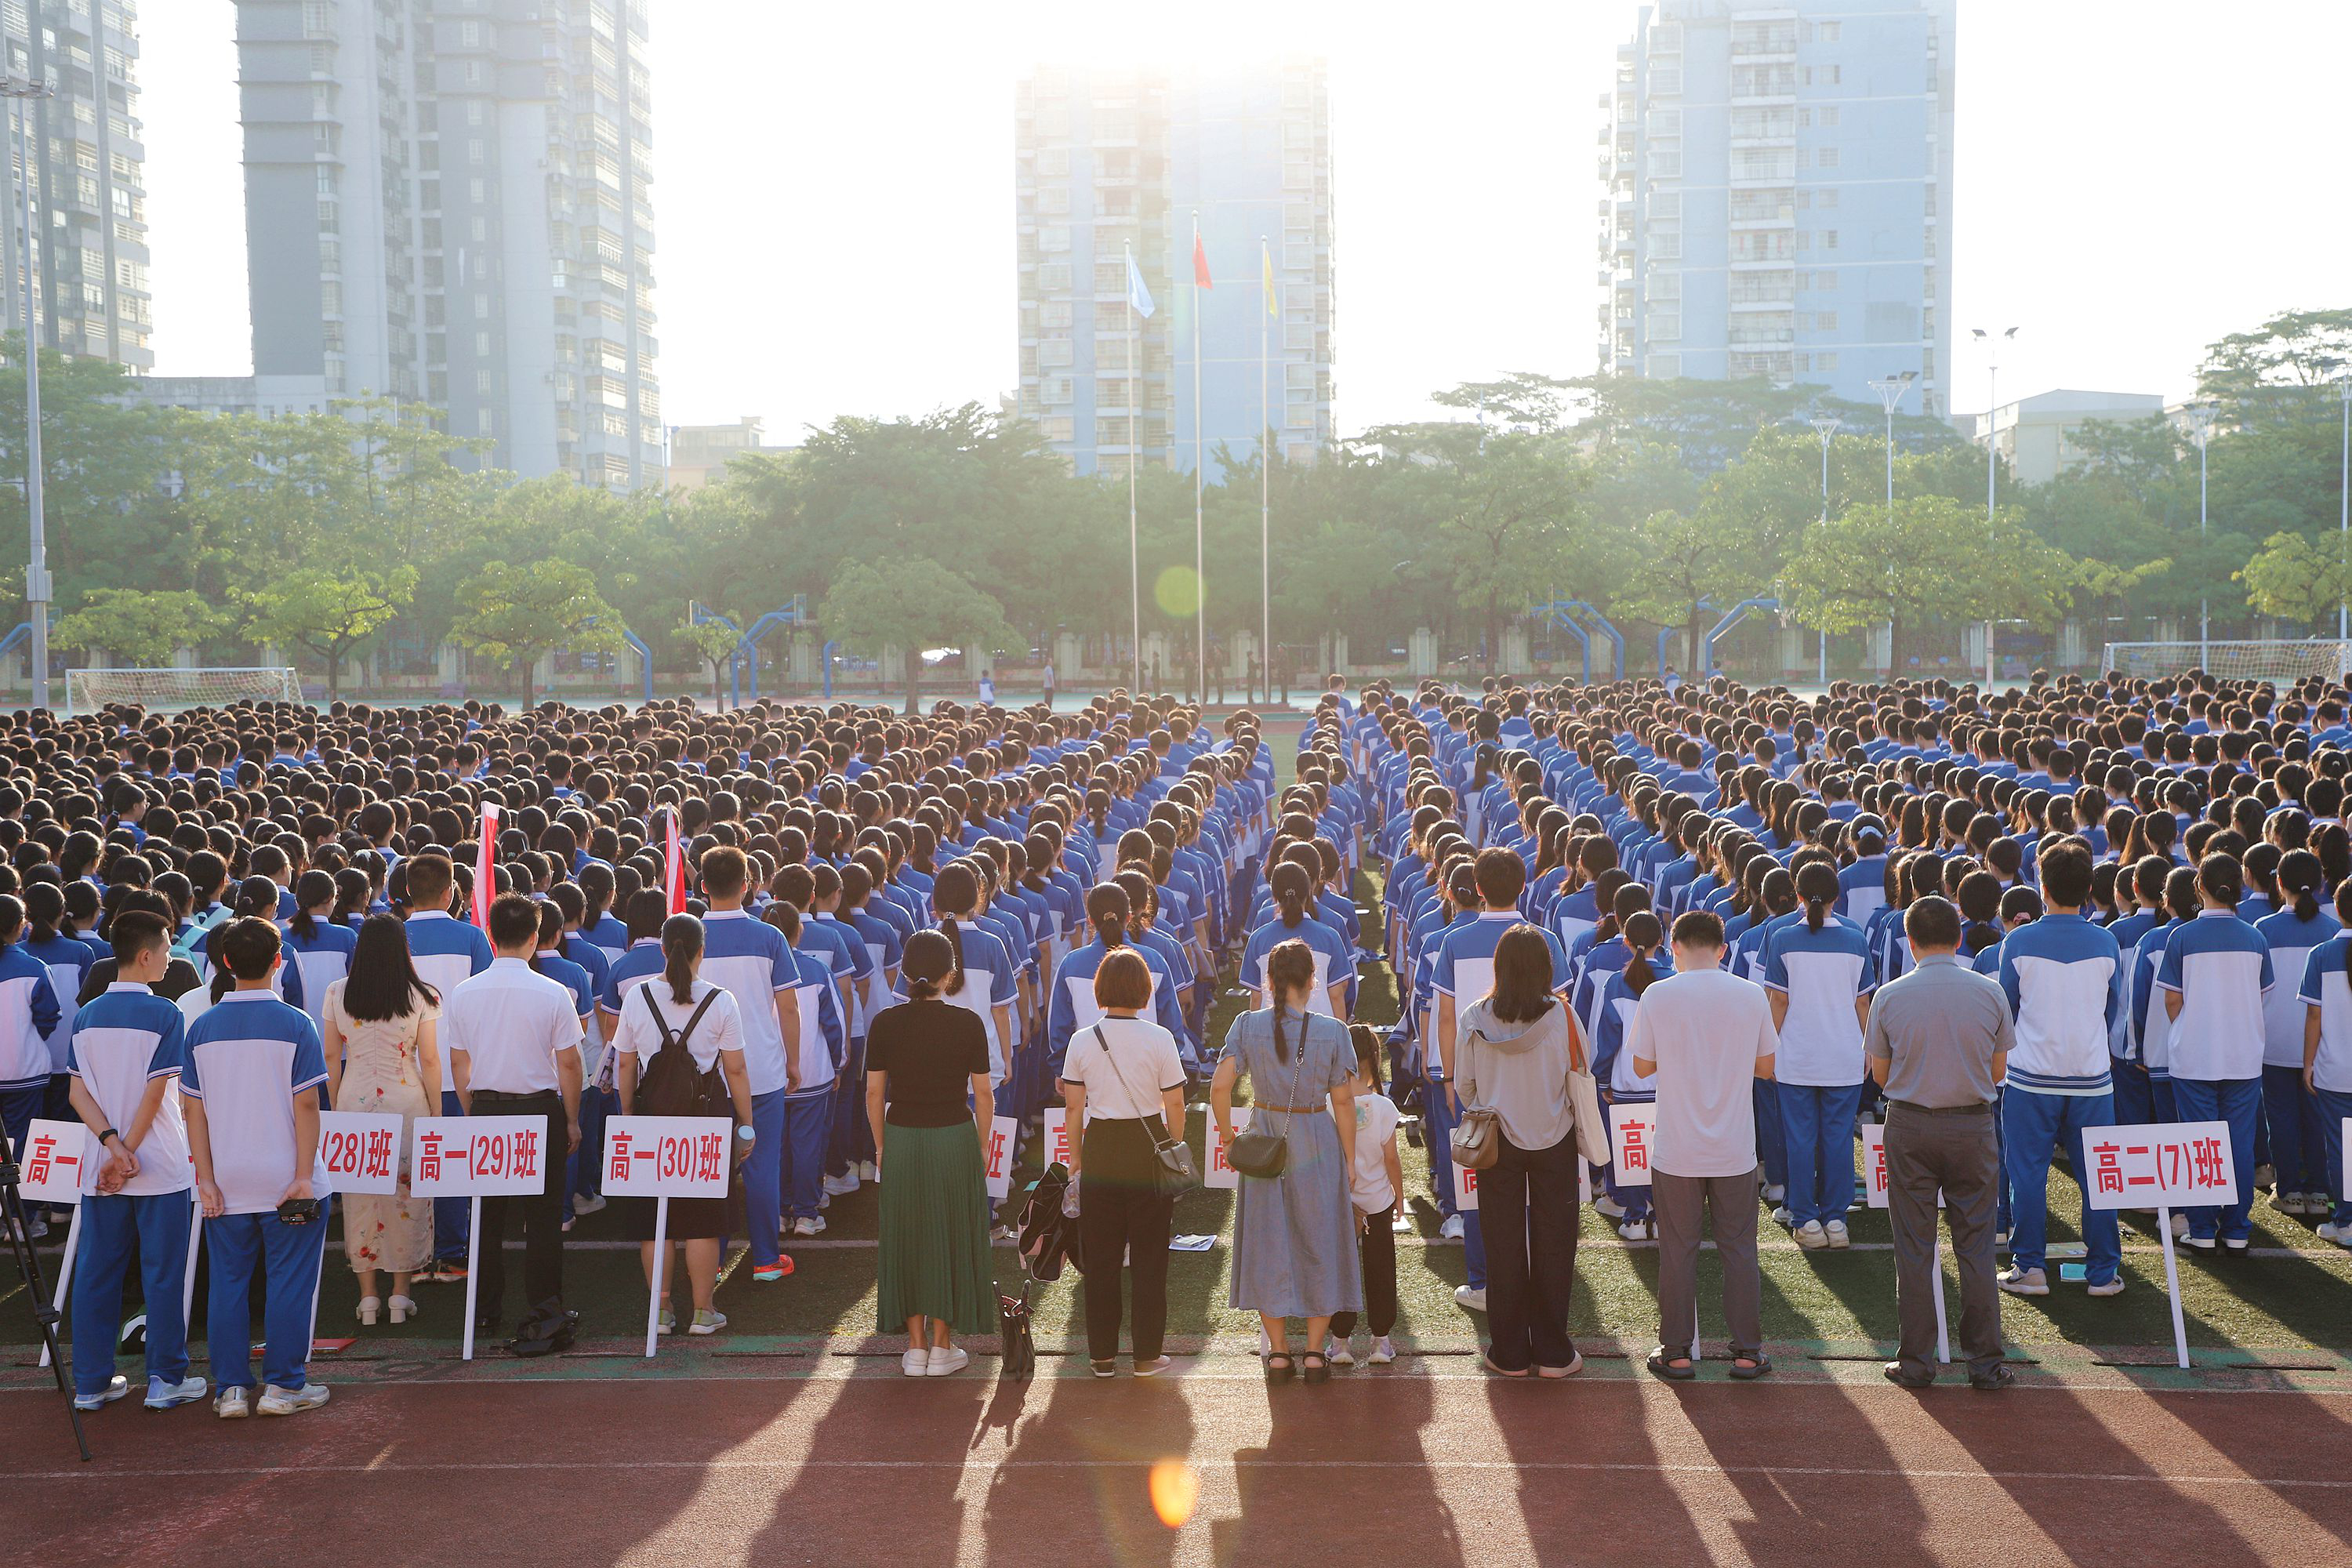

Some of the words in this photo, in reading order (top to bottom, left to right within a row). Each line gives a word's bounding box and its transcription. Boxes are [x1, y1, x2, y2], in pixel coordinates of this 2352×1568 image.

[420, 1129, 537, 1181] 高一(29)班
[610, 1131, 723, 1182] 高一(30)班
[2092, 1136, 2227, 1193] 高二(7)班
